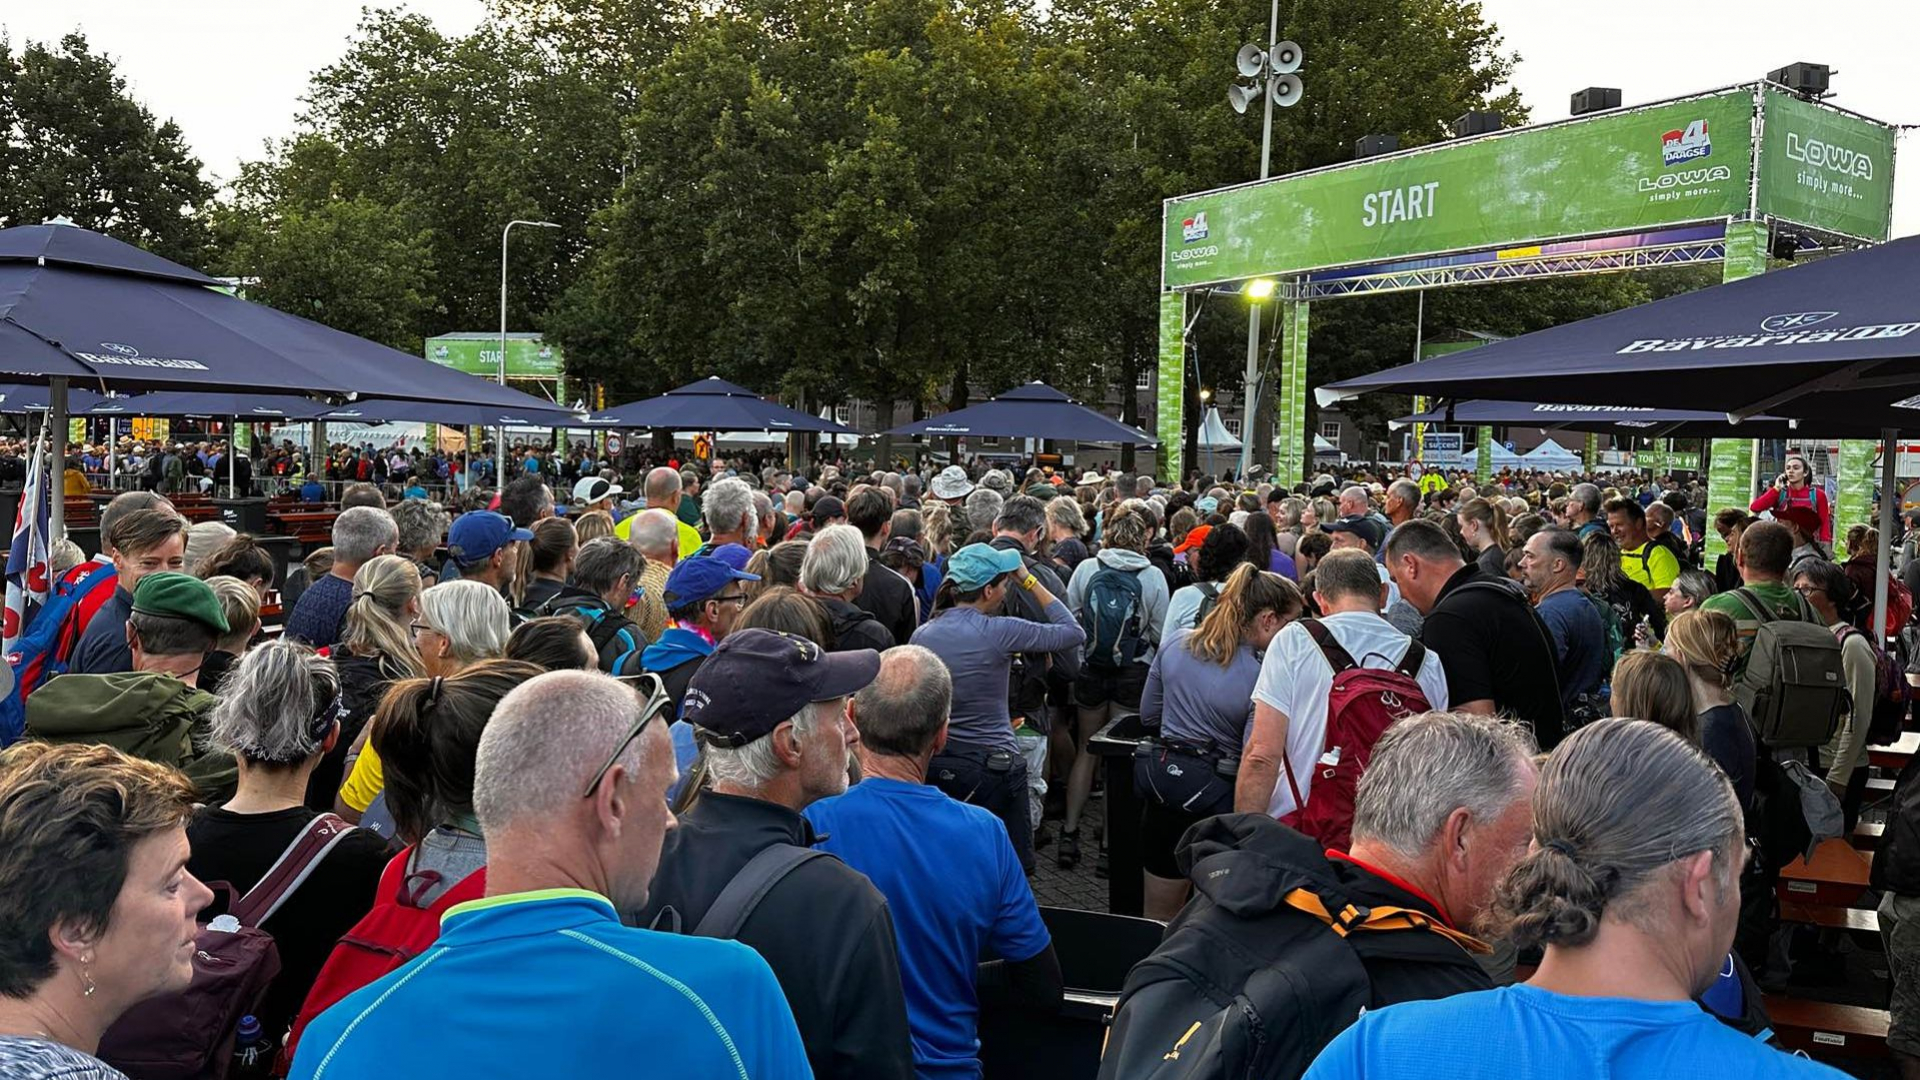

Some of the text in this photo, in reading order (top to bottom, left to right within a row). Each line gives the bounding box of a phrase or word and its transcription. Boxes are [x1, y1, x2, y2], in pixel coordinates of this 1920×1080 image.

[1666, 119, 1706, 147] DE 4
[1665, 146, 1706, 161] DAAGSE
[1786, 132, 1873, 181] LOWA
[1639, 166, 1731, 192] LOWA
[1797, 170, 1864, 200] simply more...
[1362, 181, 1440, 227] START
[1649, 187, 1721, 202] simply more...
[1171, 245, 1218, 261] LOWA
[1615, 330, 1838, 354] Bavaria
